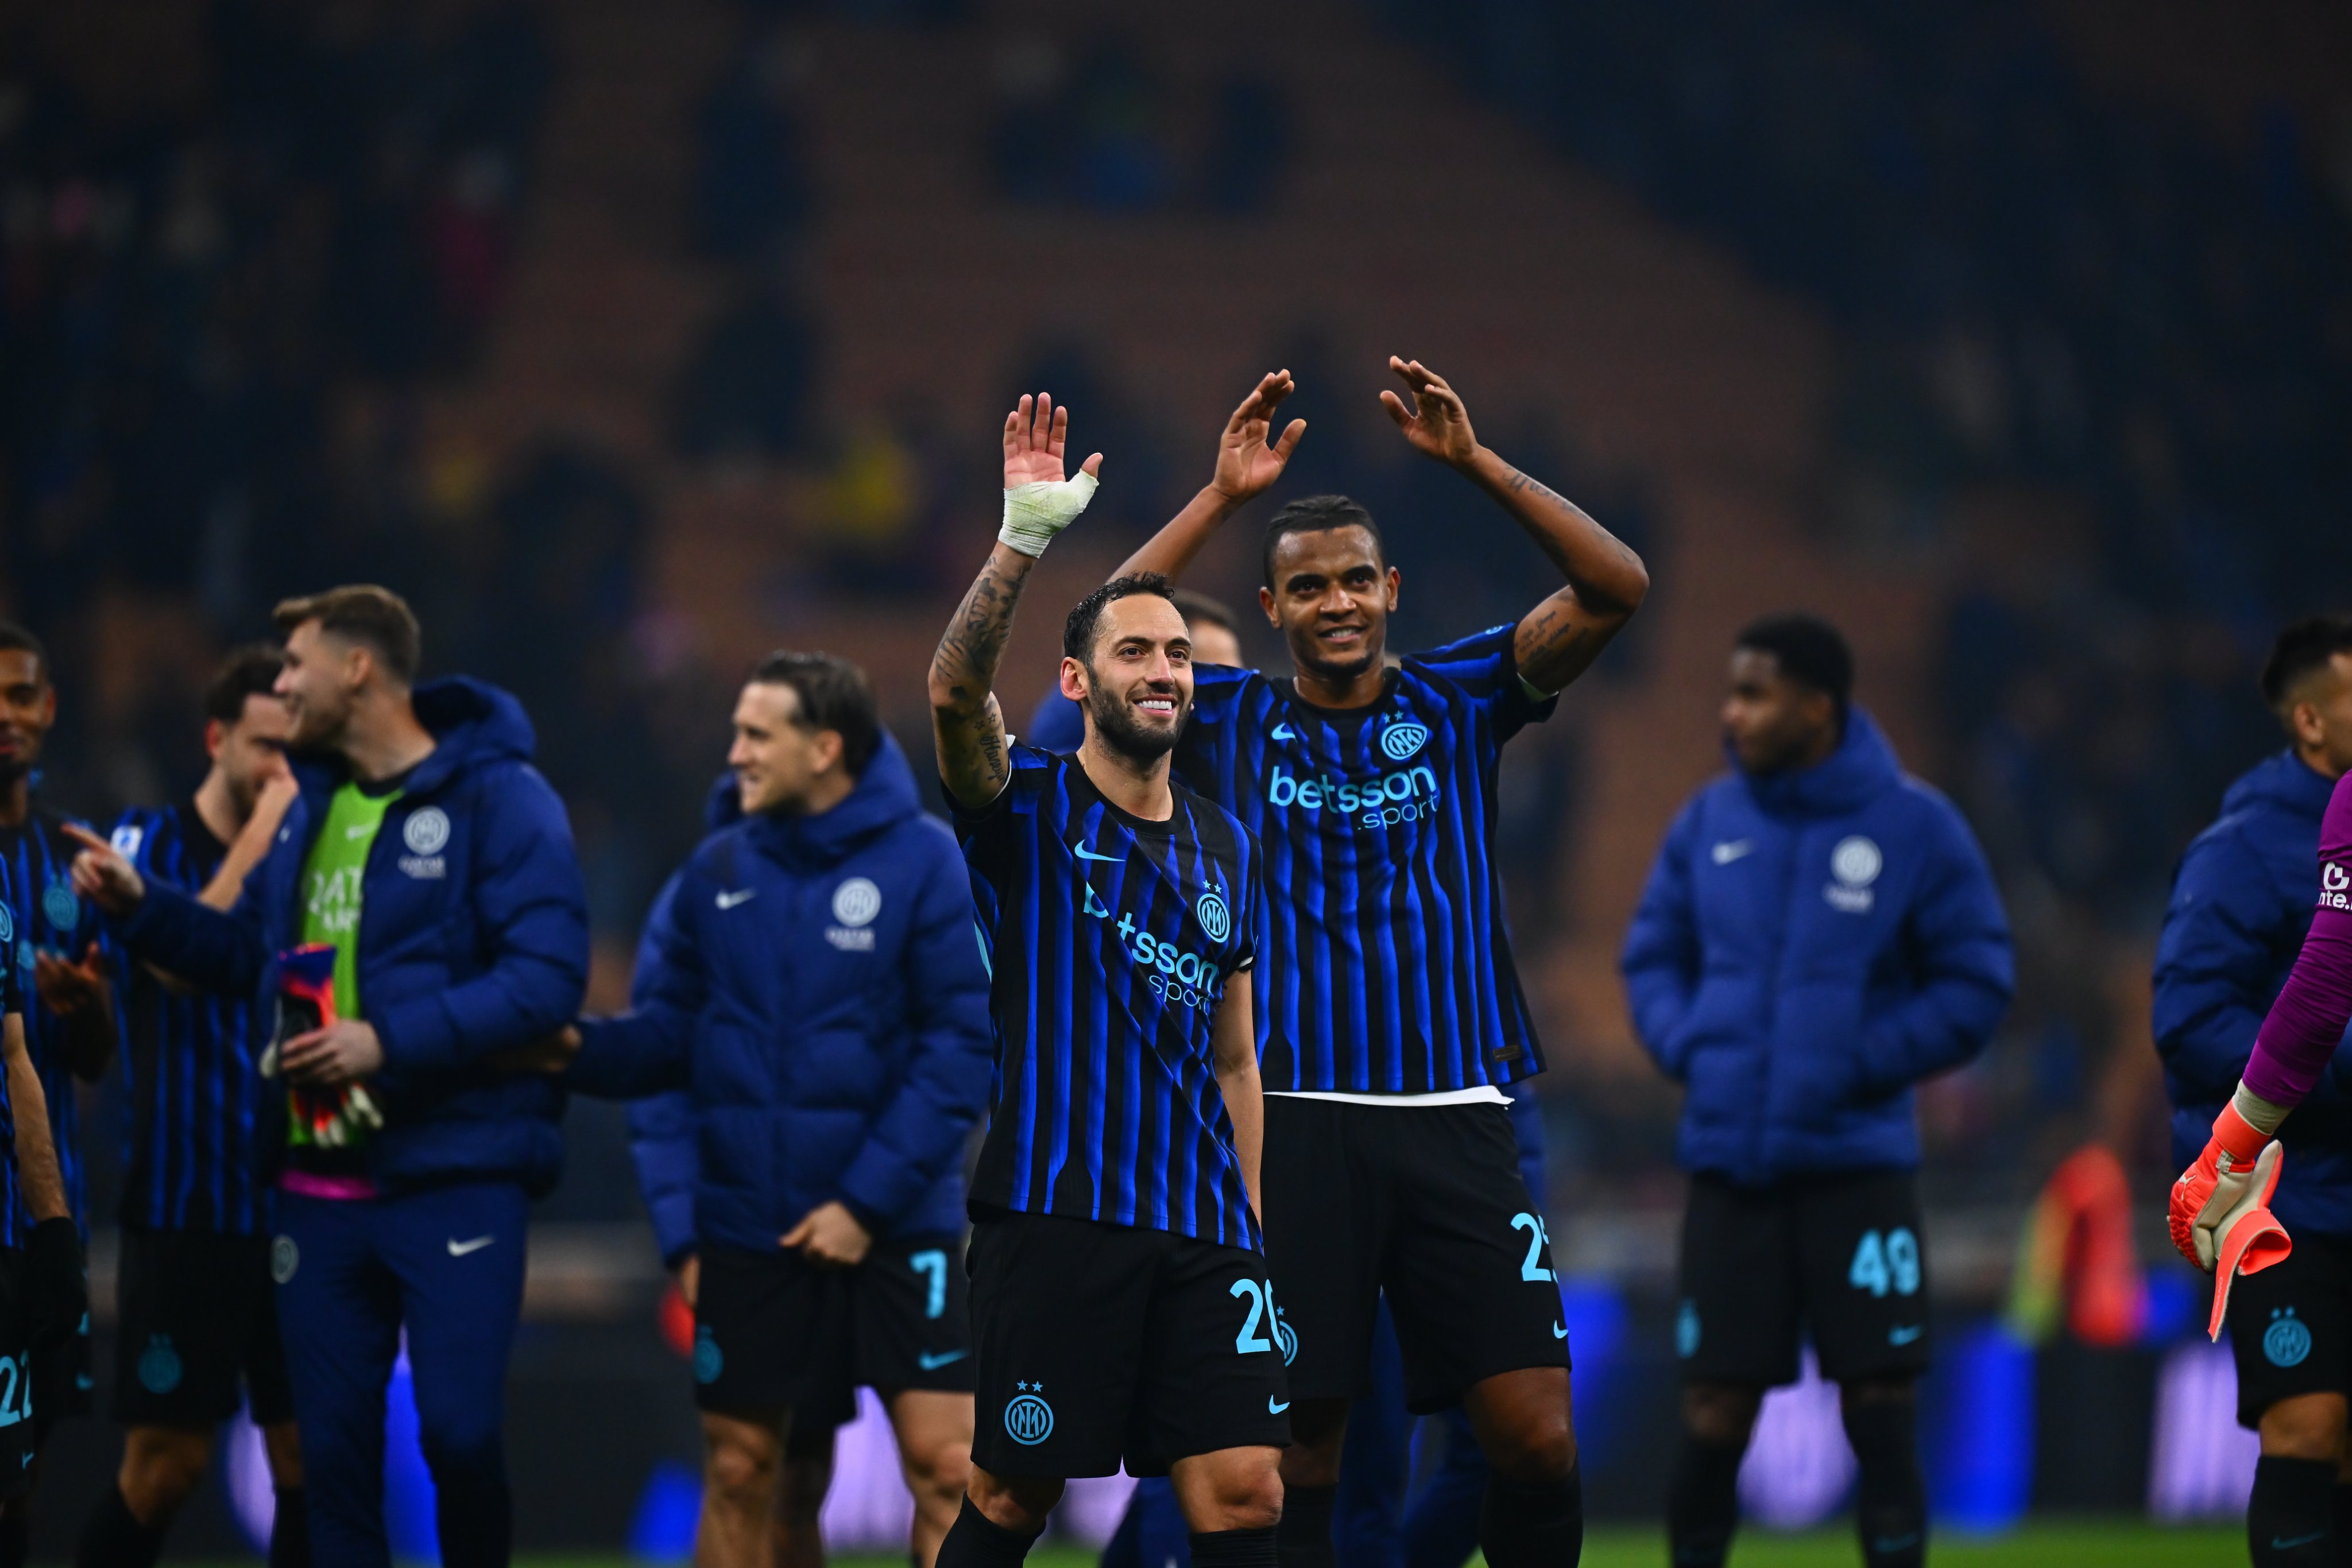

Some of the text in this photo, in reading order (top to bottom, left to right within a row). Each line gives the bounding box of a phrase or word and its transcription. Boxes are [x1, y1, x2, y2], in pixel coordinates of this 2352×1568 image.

[1269, 765, 1436, 814] betsson
[1357, 794, 1438, 831] .sport
[1083, 881, 1219, 998] btsson
[908, 1248, 948, 1319] 7
[1847, 1226, 1921, 1298] 49
